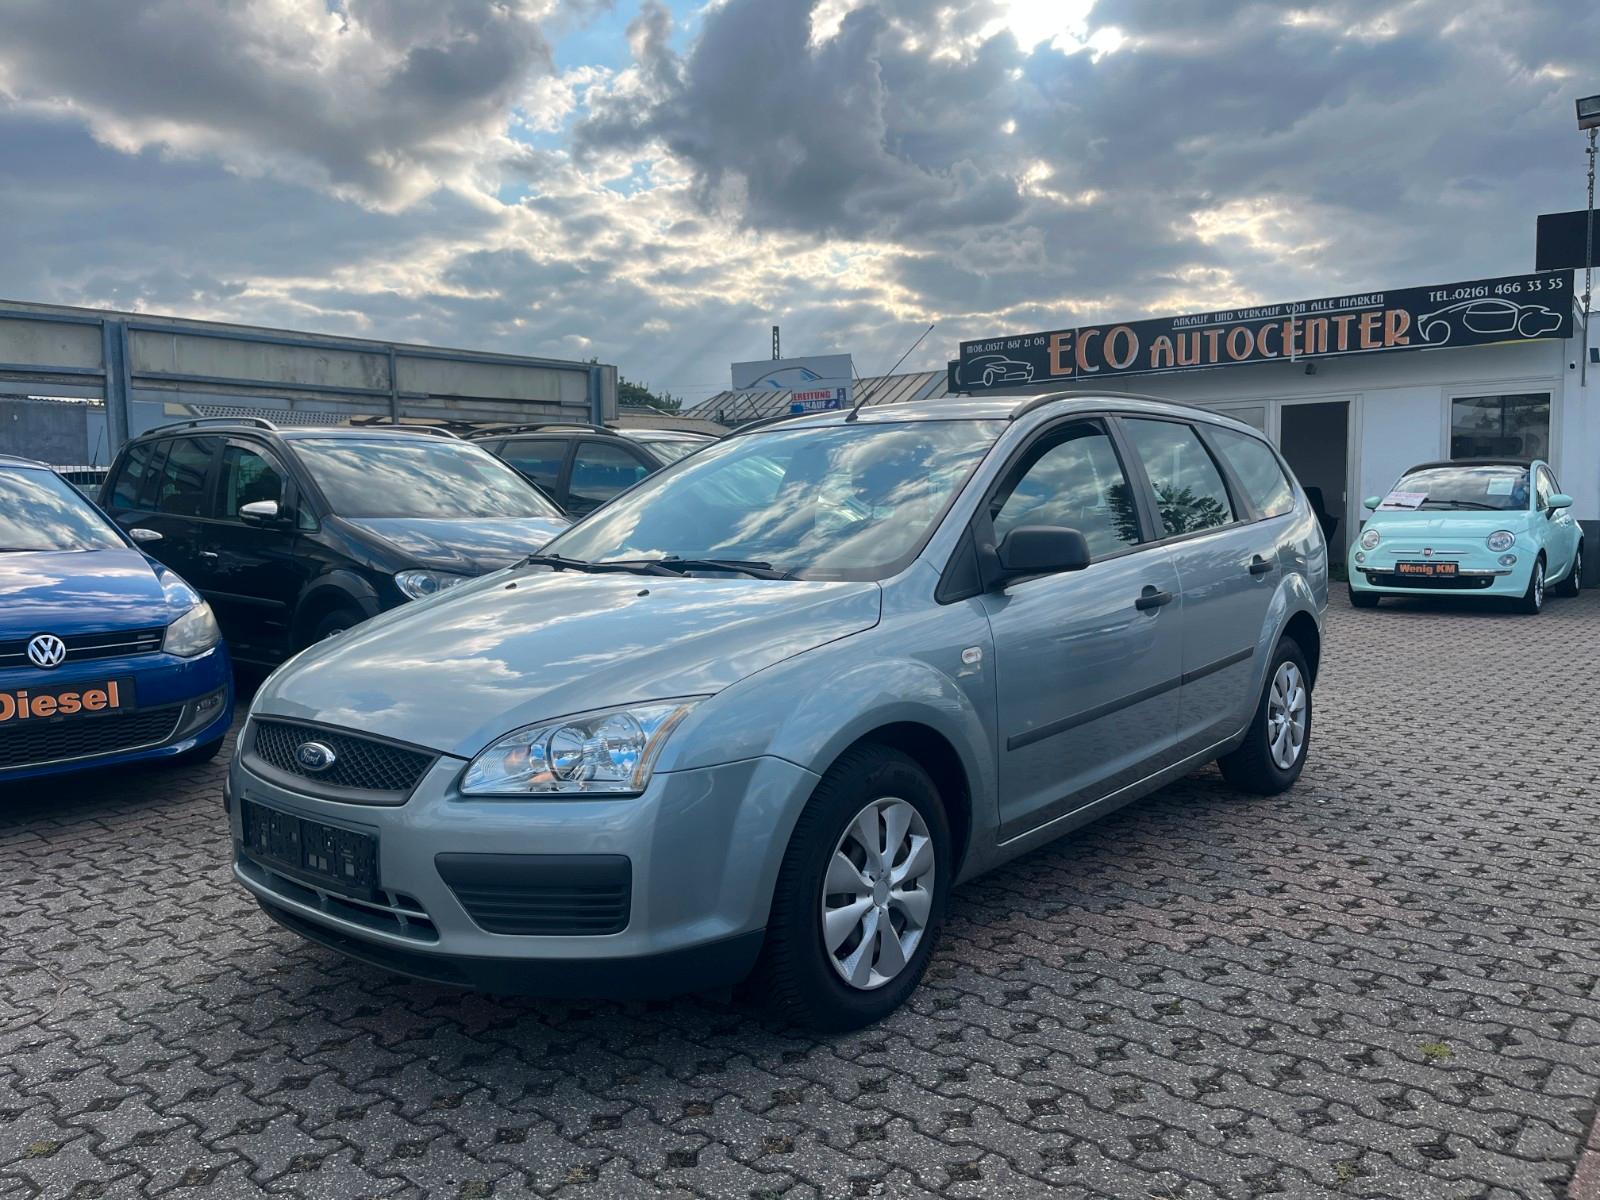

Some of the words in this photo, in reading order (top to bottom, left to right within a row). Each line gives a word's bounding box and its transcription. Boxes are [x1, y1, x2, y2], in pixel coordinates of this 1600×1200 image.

[1494, 282, 1521, 295] 466
[1527, 280, 1542, 292] 33
[1548, 278, 1563, 289] 55
[1173, 315, 1209, 327] ANKAUF
[1214, 311, 1234, 322] UND
[1237, 306, 1281, 319] VERKAUF
[1285, 303, 1306, 314] VON
[1310, 299, 1335, 311] ALLE
[1339, 294, 1384, 307] MARKEN
[1024, 338, 1031, 347] 21
[1033, 336, 1045, 346] 08
[1047, 326, 1139, 375] ECO
[1149, 309, 1410, 368] AUTOCENTER
[1399, 564, 1433, 575] Wenig
[1436, 565, 1456, 573] KM
[30, 636, 64, 665] VW
[0, 680, 120, 721] Diesel
[303, 747, 320, 765] Ford
